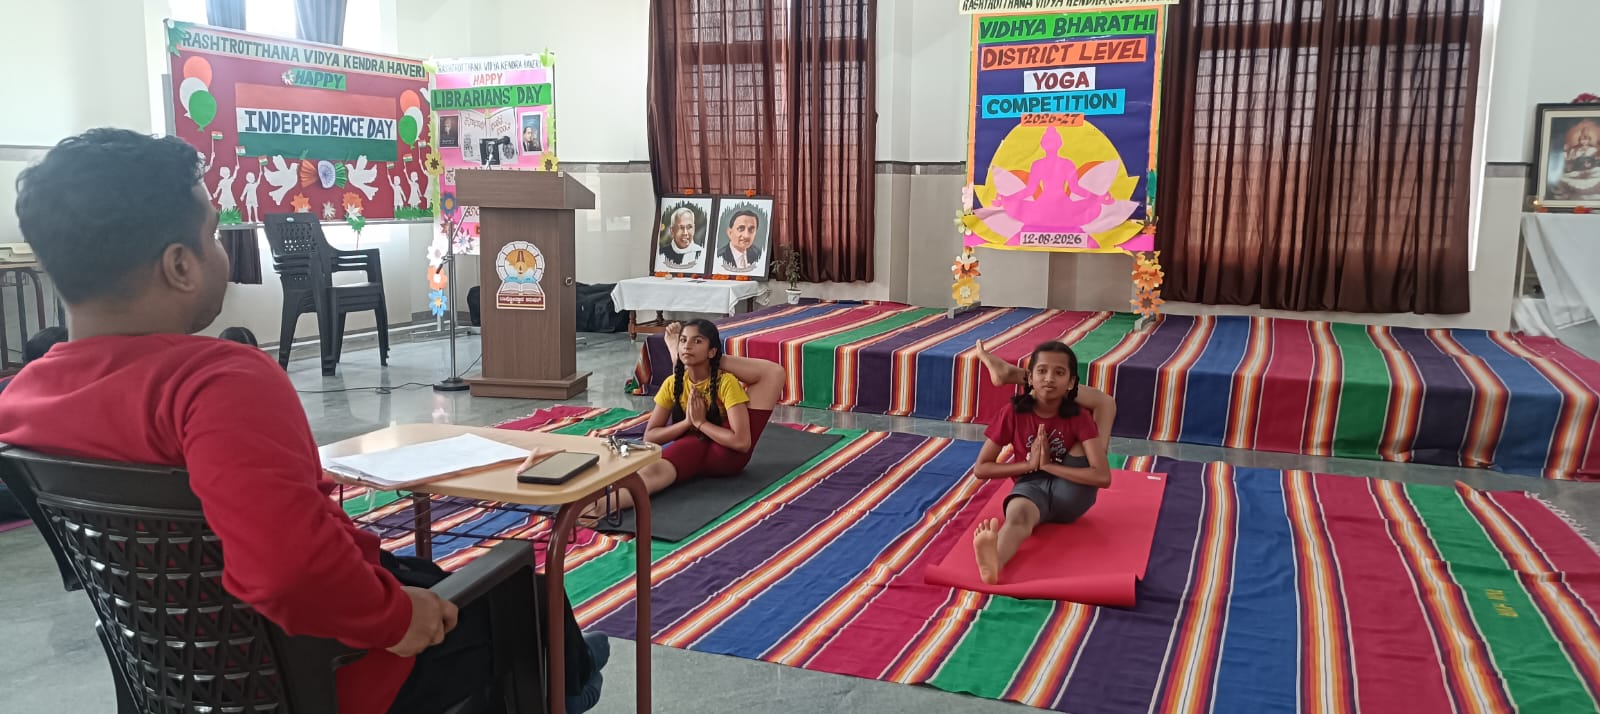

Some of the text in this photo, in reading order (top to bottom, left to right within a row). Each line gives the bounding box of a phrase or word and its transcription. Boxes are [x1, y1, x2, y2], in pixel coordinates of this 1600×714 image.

[980, 14, 1156, 39] VIDHYA BHARATHI
[182, 31, 426, 78] RASHTROTTHANA VIDYA KENDRA HAVERI
[982, 40, 1145, 69] DISTRICT LEVEL
[295, 70, 344, 89] HAPPY
[473, 73, 504, 86] HAPPY
[1033, 71, 1090, 91] YOGA
[517, 85, 543, 104] DAY
[986, 92, 1118, 115] COMPETITION
[244, 110, 394, 139] INDEPENDENCE DAY
